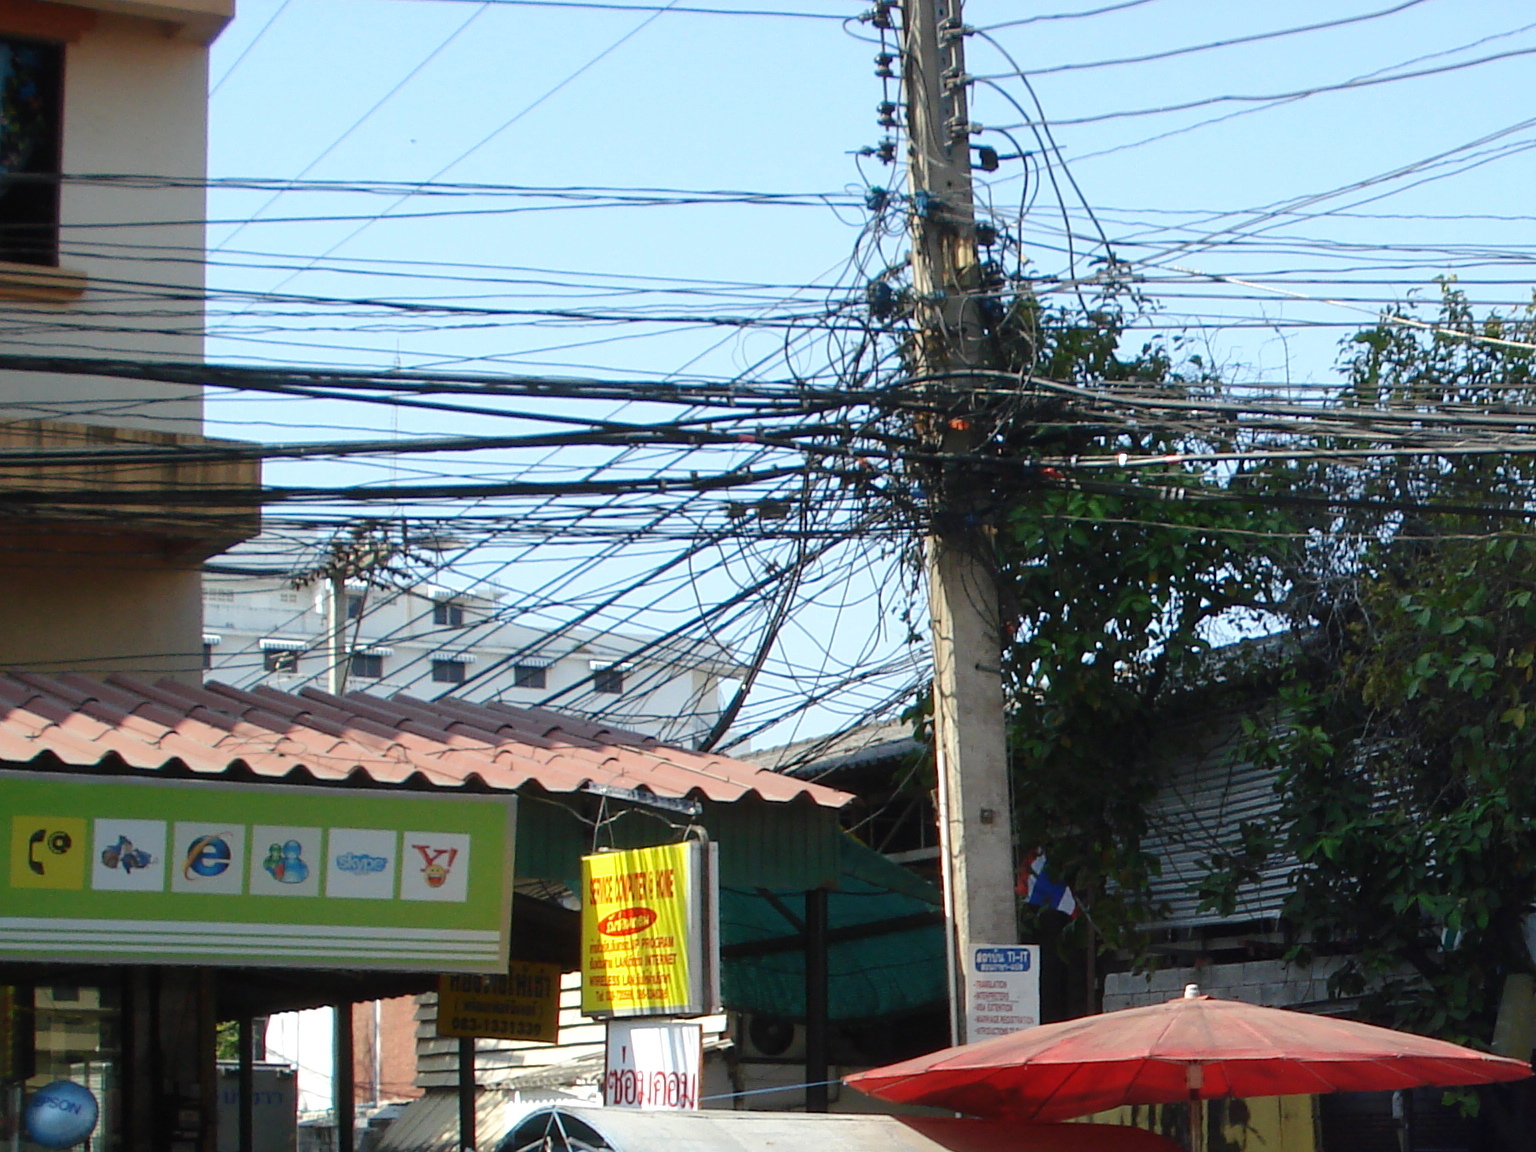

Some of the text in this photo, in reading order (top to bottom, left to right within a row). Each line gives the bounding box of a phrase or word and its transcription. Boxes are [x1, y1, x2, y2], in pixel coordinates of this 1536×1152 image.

[337, 852, 387, 875] skype
[656, 868, 674, 899] HOME
[641, 936, 674, 949] PROGRAM
[644, 953, 677, 966] INTERNET
[589, 975, 620, 987] WIRELESS
[608, 1045, 696, 1109] ซ่อมคอม
